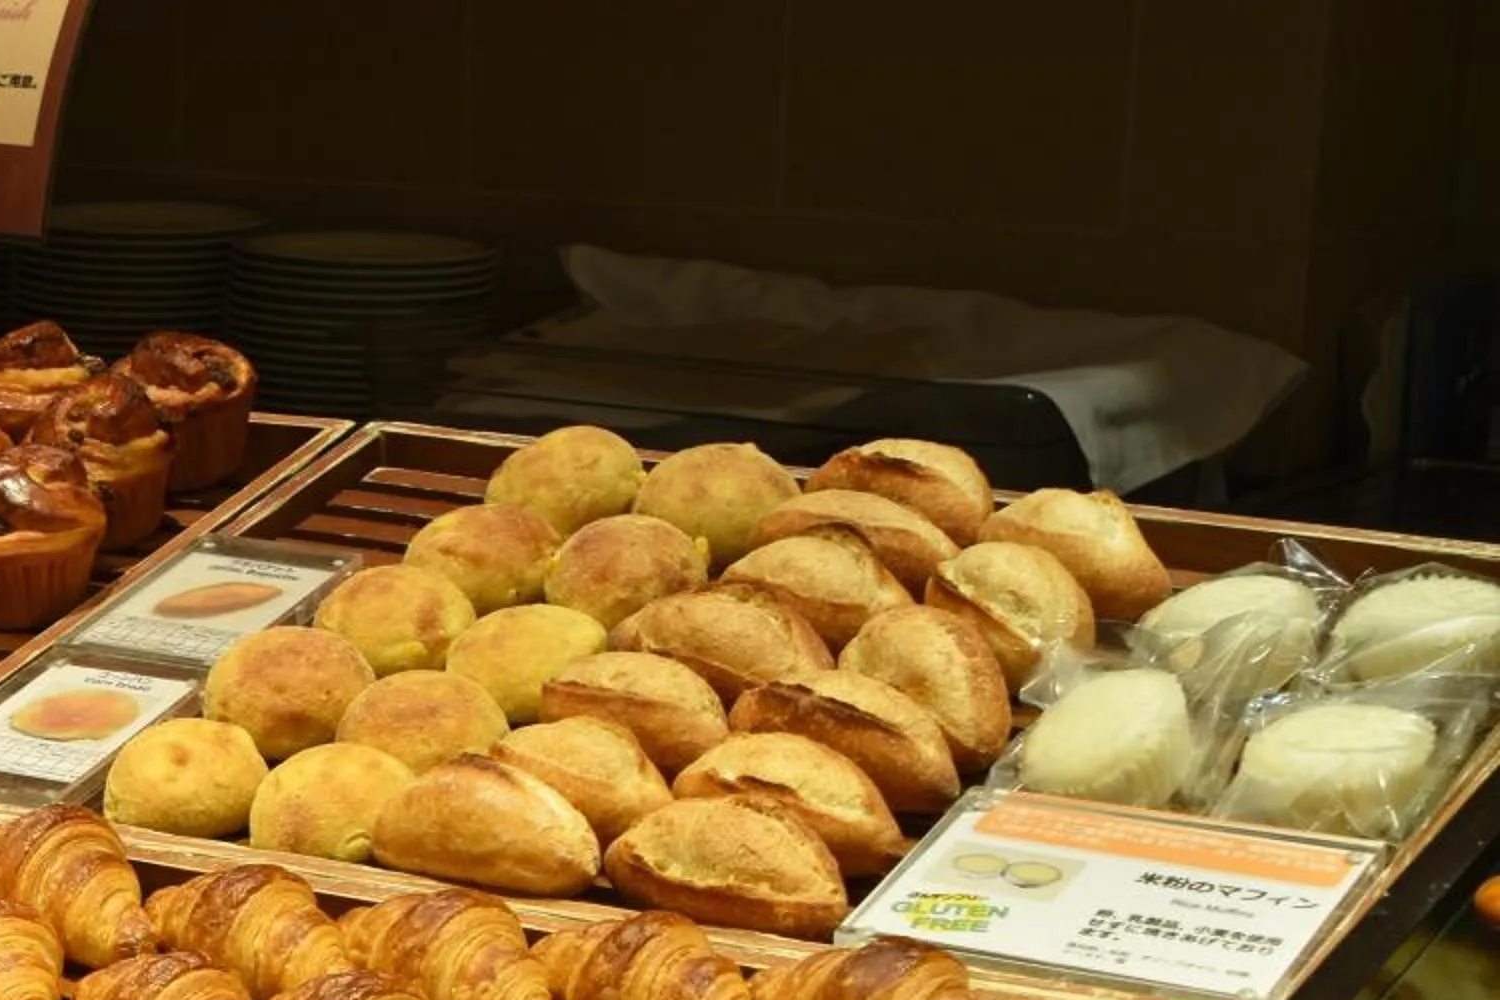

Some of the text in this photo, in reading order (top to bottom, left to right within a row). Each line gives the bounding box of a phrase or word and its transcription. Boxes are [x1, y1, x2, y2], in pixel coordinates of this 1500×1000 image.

[1135, 872, 1320, 909] 米粉のマフィン
[891, 901, 1009, 918] GLUTEN
[910, 917, 989, 932] FREE
